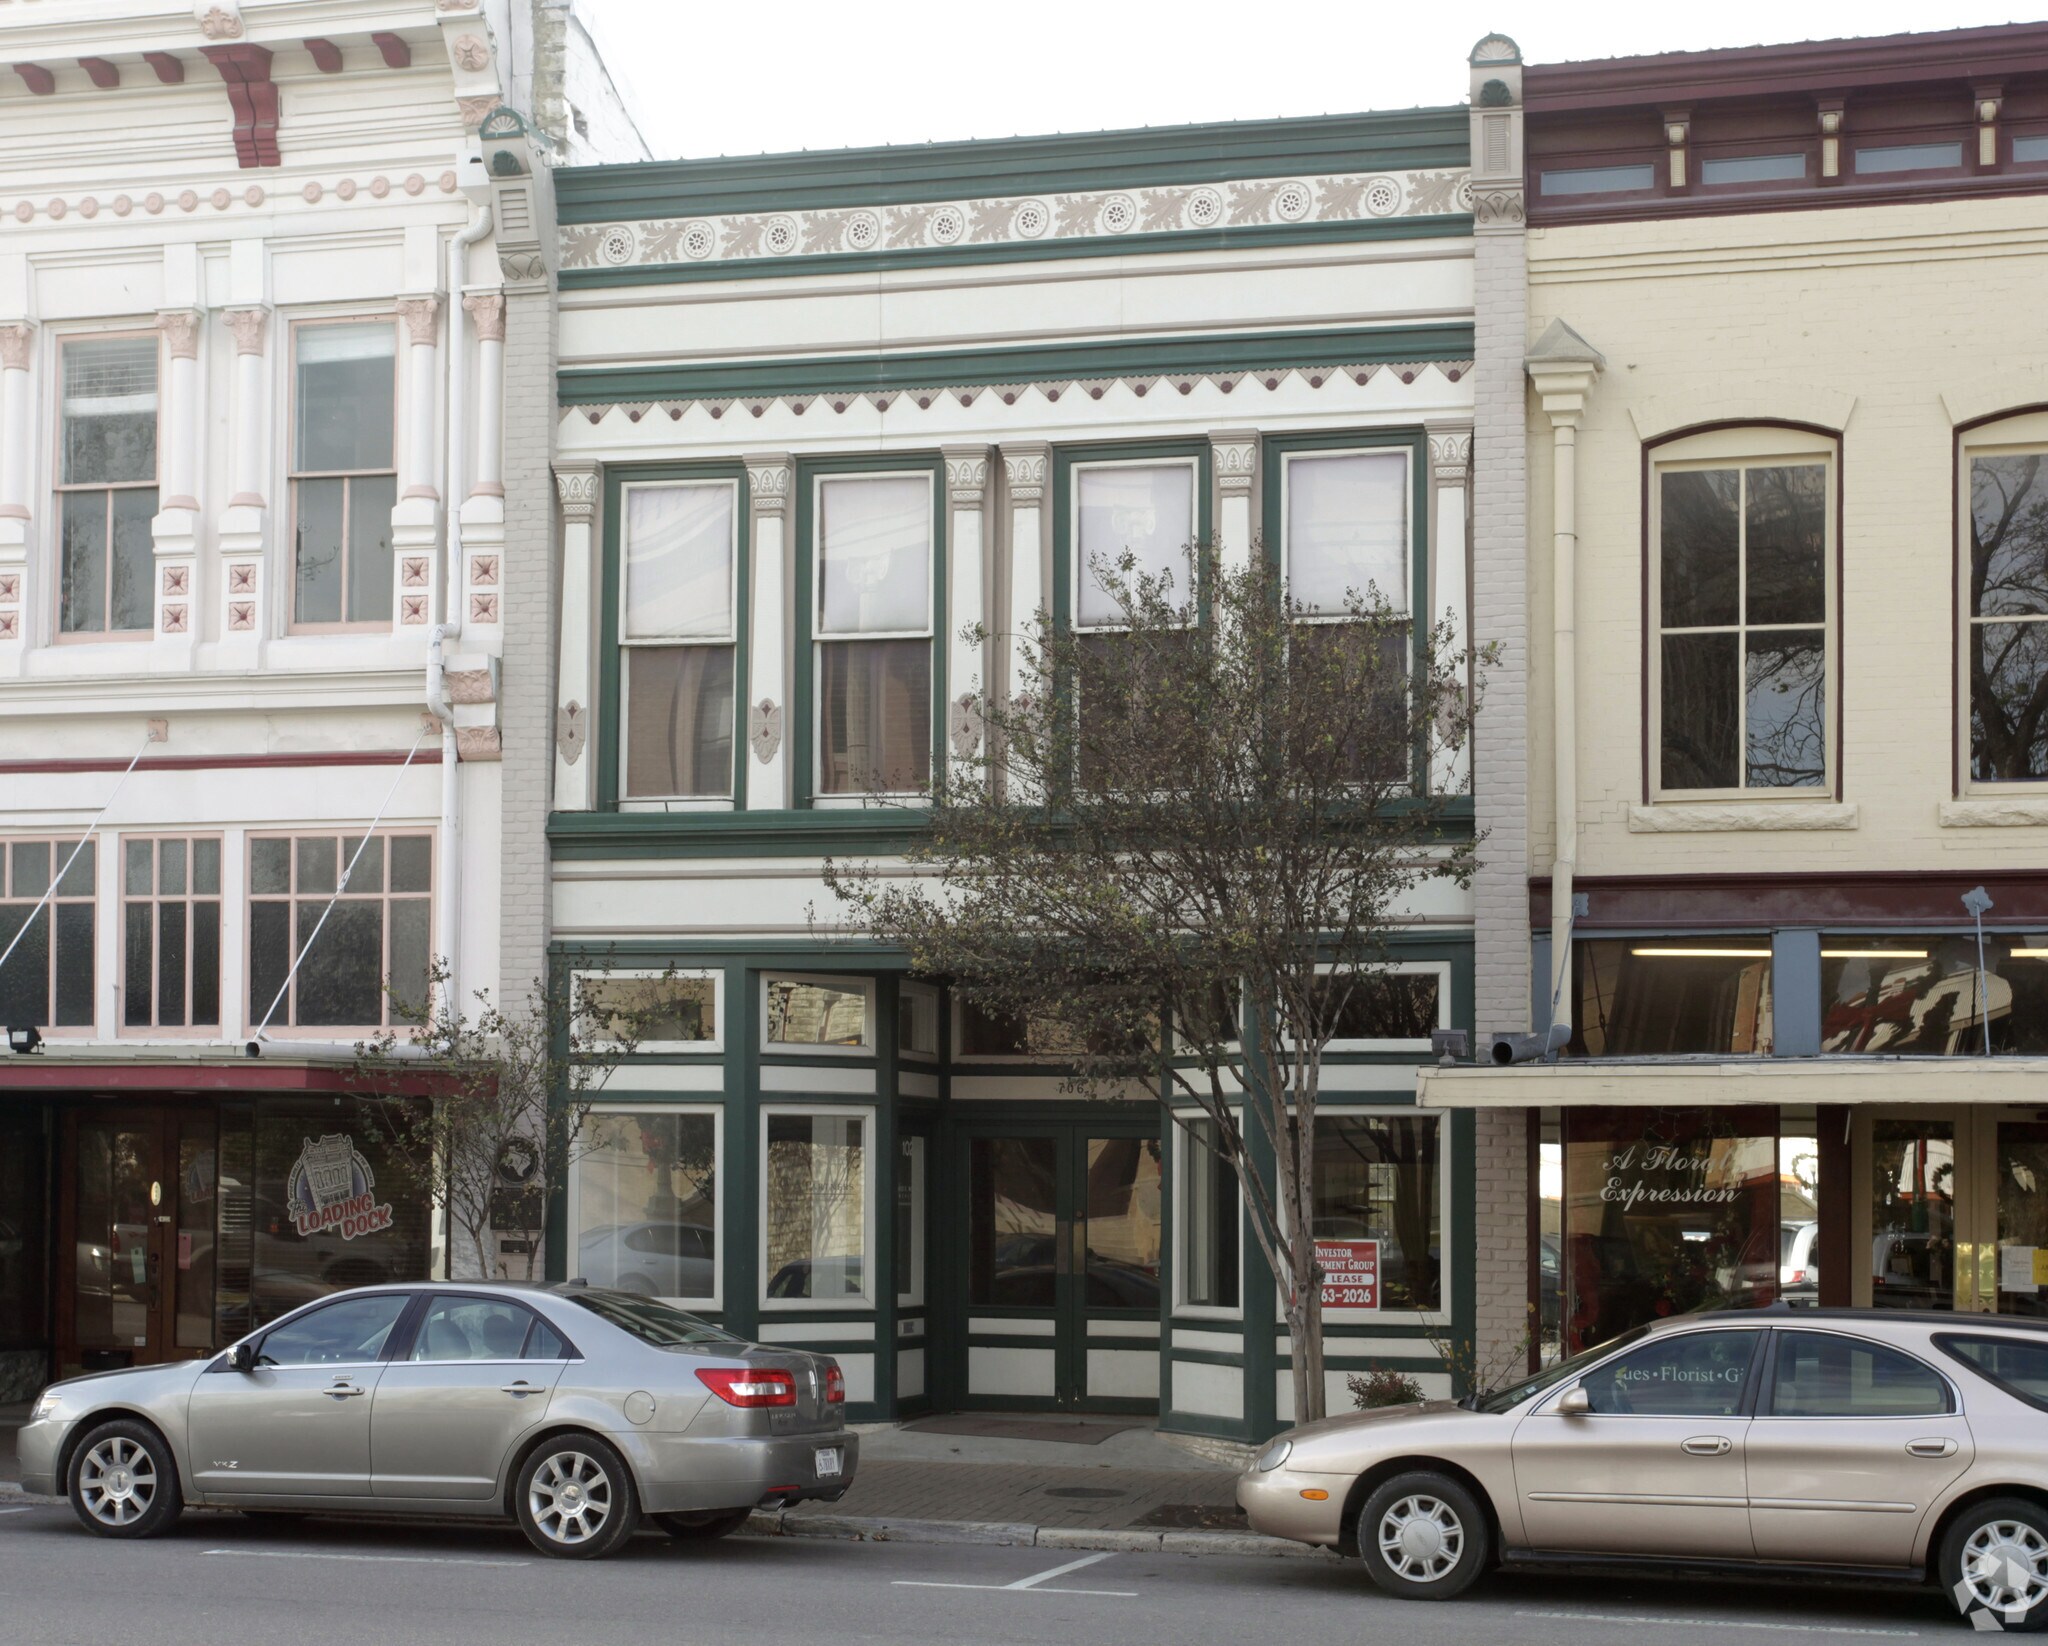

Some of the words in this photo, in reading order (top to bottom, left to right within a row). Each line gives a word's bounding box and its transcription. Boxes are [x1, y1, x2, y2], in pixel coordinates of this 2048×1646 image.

[1058, 1082, 1084, 1094] 706
[1602, 1145, 1636, 1170] A
[1641, 1145, 1734, 1171] Floral
[1600, 1177, 1742, 1211] Expression
[299, 1194, 372, 1233] LOADING
[343, 1206, 390, 1237] DOCK
[1315, 1245, 1352, 1257] INVESTOR
[1317, 1261, 1346, 1270] EMENT
[1348, 1259, 1374, 1270] GROUP
[1332, 1275, 1363, 1283] LEASE
[1321, 1289, 1371, 1303] 63-2026
[1622, 1369, 1650, 1380] ues
[1661, 1367, 1715, 1381] Florist
